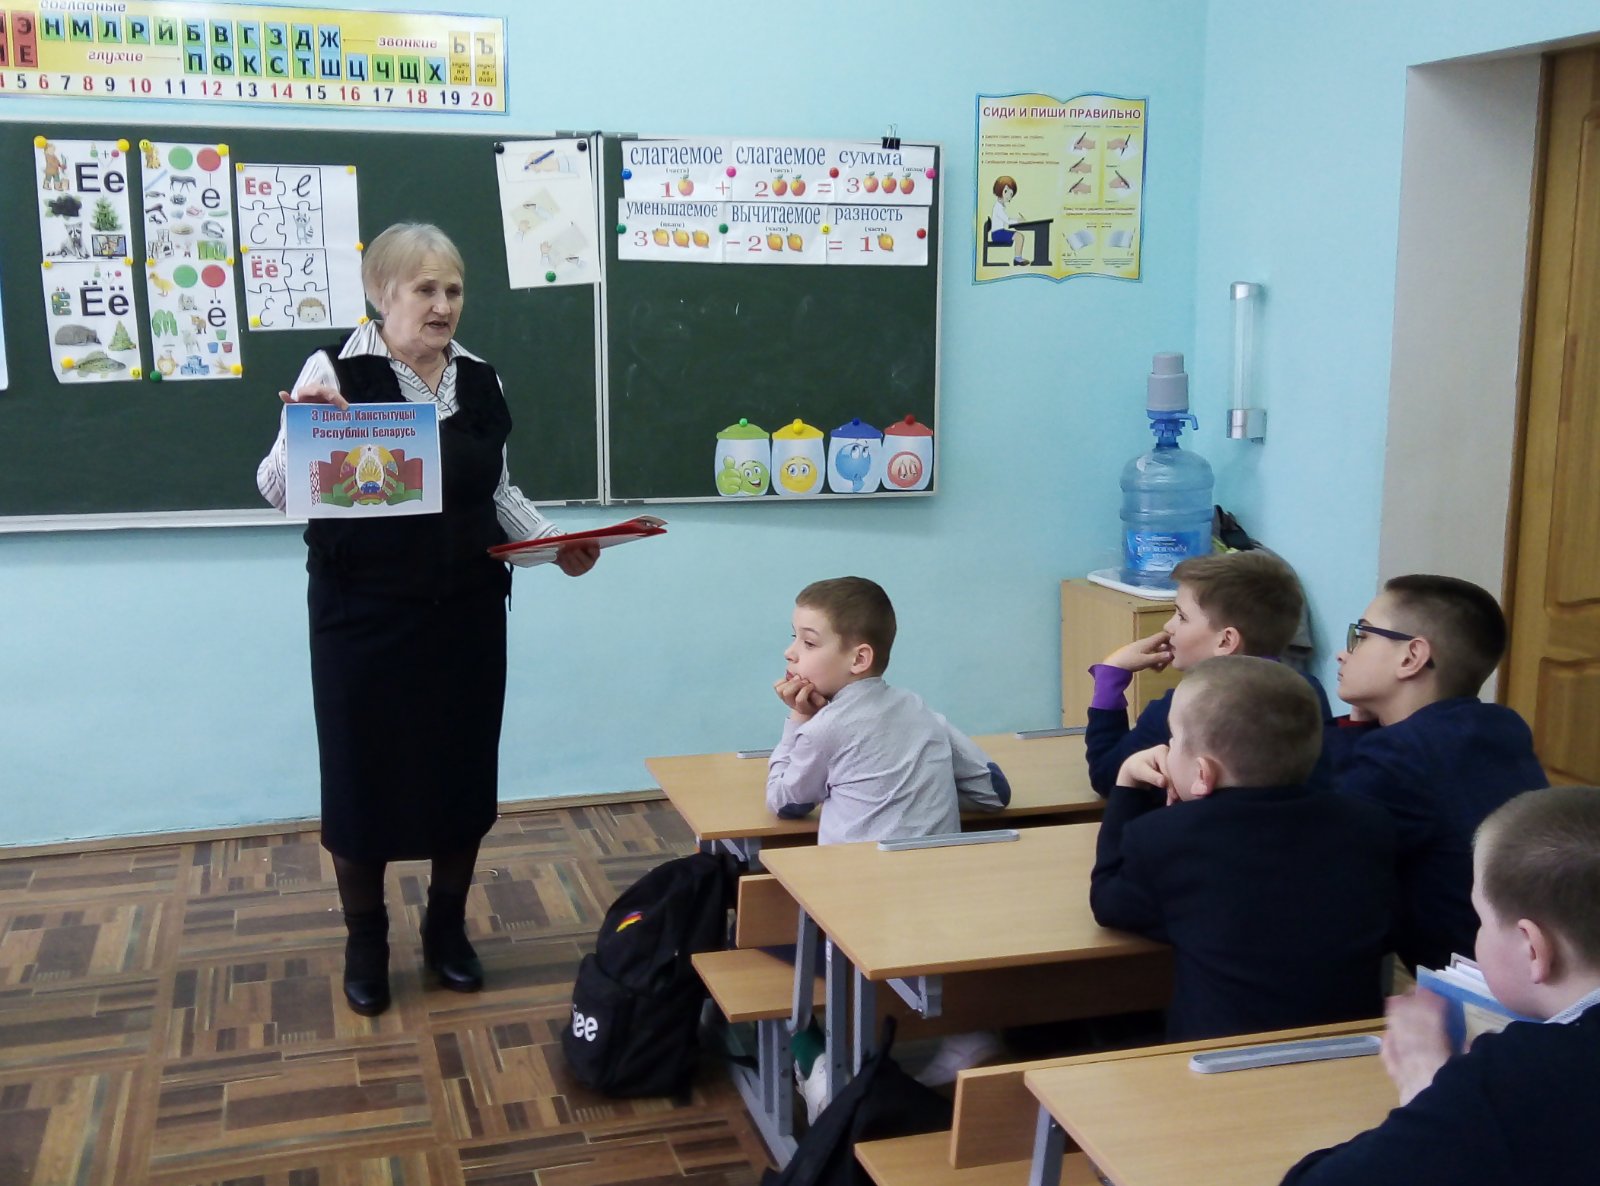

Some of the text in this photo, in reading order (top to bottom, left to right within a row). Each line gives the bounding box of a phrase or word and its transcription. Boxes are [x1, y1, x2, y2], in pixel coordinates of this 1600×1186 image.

[17, 17, 32, 35] Э
[45, 18, 60, 35] Н
[72, 19, 90, 37] М
[103, 21, 117, 38] Л
[131, 22, 144, 39] Р
[158, 18, 173, 41] Й
[187, 25, 200, 41] Б
[215, 26, 228, 42] В
[243, 27, 254, 44] Г
[270, 28, 282, 45] З
[295, 30, 311, 50] Д
[320, 30, 339, 48] Ж
[378, 37, 438, 49] звонкие
[20, 45, 33, 63] Е
[88, 50, 143, 64] глухие
[188, 53, 203, 71] П
[213, 53, 232, 72] Ф
[244, 55, 257, 74] К
[270, 56, 284, 74] С
[297, 58, 310, 75] Т
[321, 59, 340, 77] Ш
[349, 60, 365, 81] Ц
[377, 61, 389, 79] Ч
[400, 62, 419, 84] Щ
[429, 63, 442, 81] Х
[17, 73, 27, 89] 5
[39, 74, 49, 89] 6
[61, 75, 71, 90] 7
[83, 76, 93, 91] 8
[105, 77, 115, 92] 9
[129, 77, 151, 93] 10
[165, 78, 186, 95] 11
[201, 80, 223, 96] 12
[236, 81, 258, 98] 13
[271, 82, 293, 98] 14
[305, 84, 327, 100] 15
[340, 86, 361, 101] 16
[373, 87, 394, 103] 17
[406, 88, 428, 104] 18
[440, 89, 460, 105] 19
[471, 91, 493, 107] 20
[983, 107, 1141, 119] СИДИ И ПИШИ ПРАВИЛЬНО
[630, 145, 903, 168] слагаемое слагаемое сумма
[75, 162, 125, 193] Ее
[244, 177, 272, 196] Ее
[660, 181, 675, 198] 1
[755, 181, 768, 197] 2
[846, 178, 860, 193] 3
[201, 187, 221, 209] е
[626, 201, 903, 225] уменьшаемое вычитаемое разность
[634, 230, 648, 247] 3
[748, 235, 762, 252] 2
[860, 236, 874, 252] 1
[251, 255, 279, 279] Ёё
[80, 281, 129, 317] Ёё
[207, 299, 226, 327] ё
[311, 409, 318, 421] З
[354, 409, 415, 421] Канстытуцыі
[312, 427, 416, 440] Рэспублікі Беларусь
